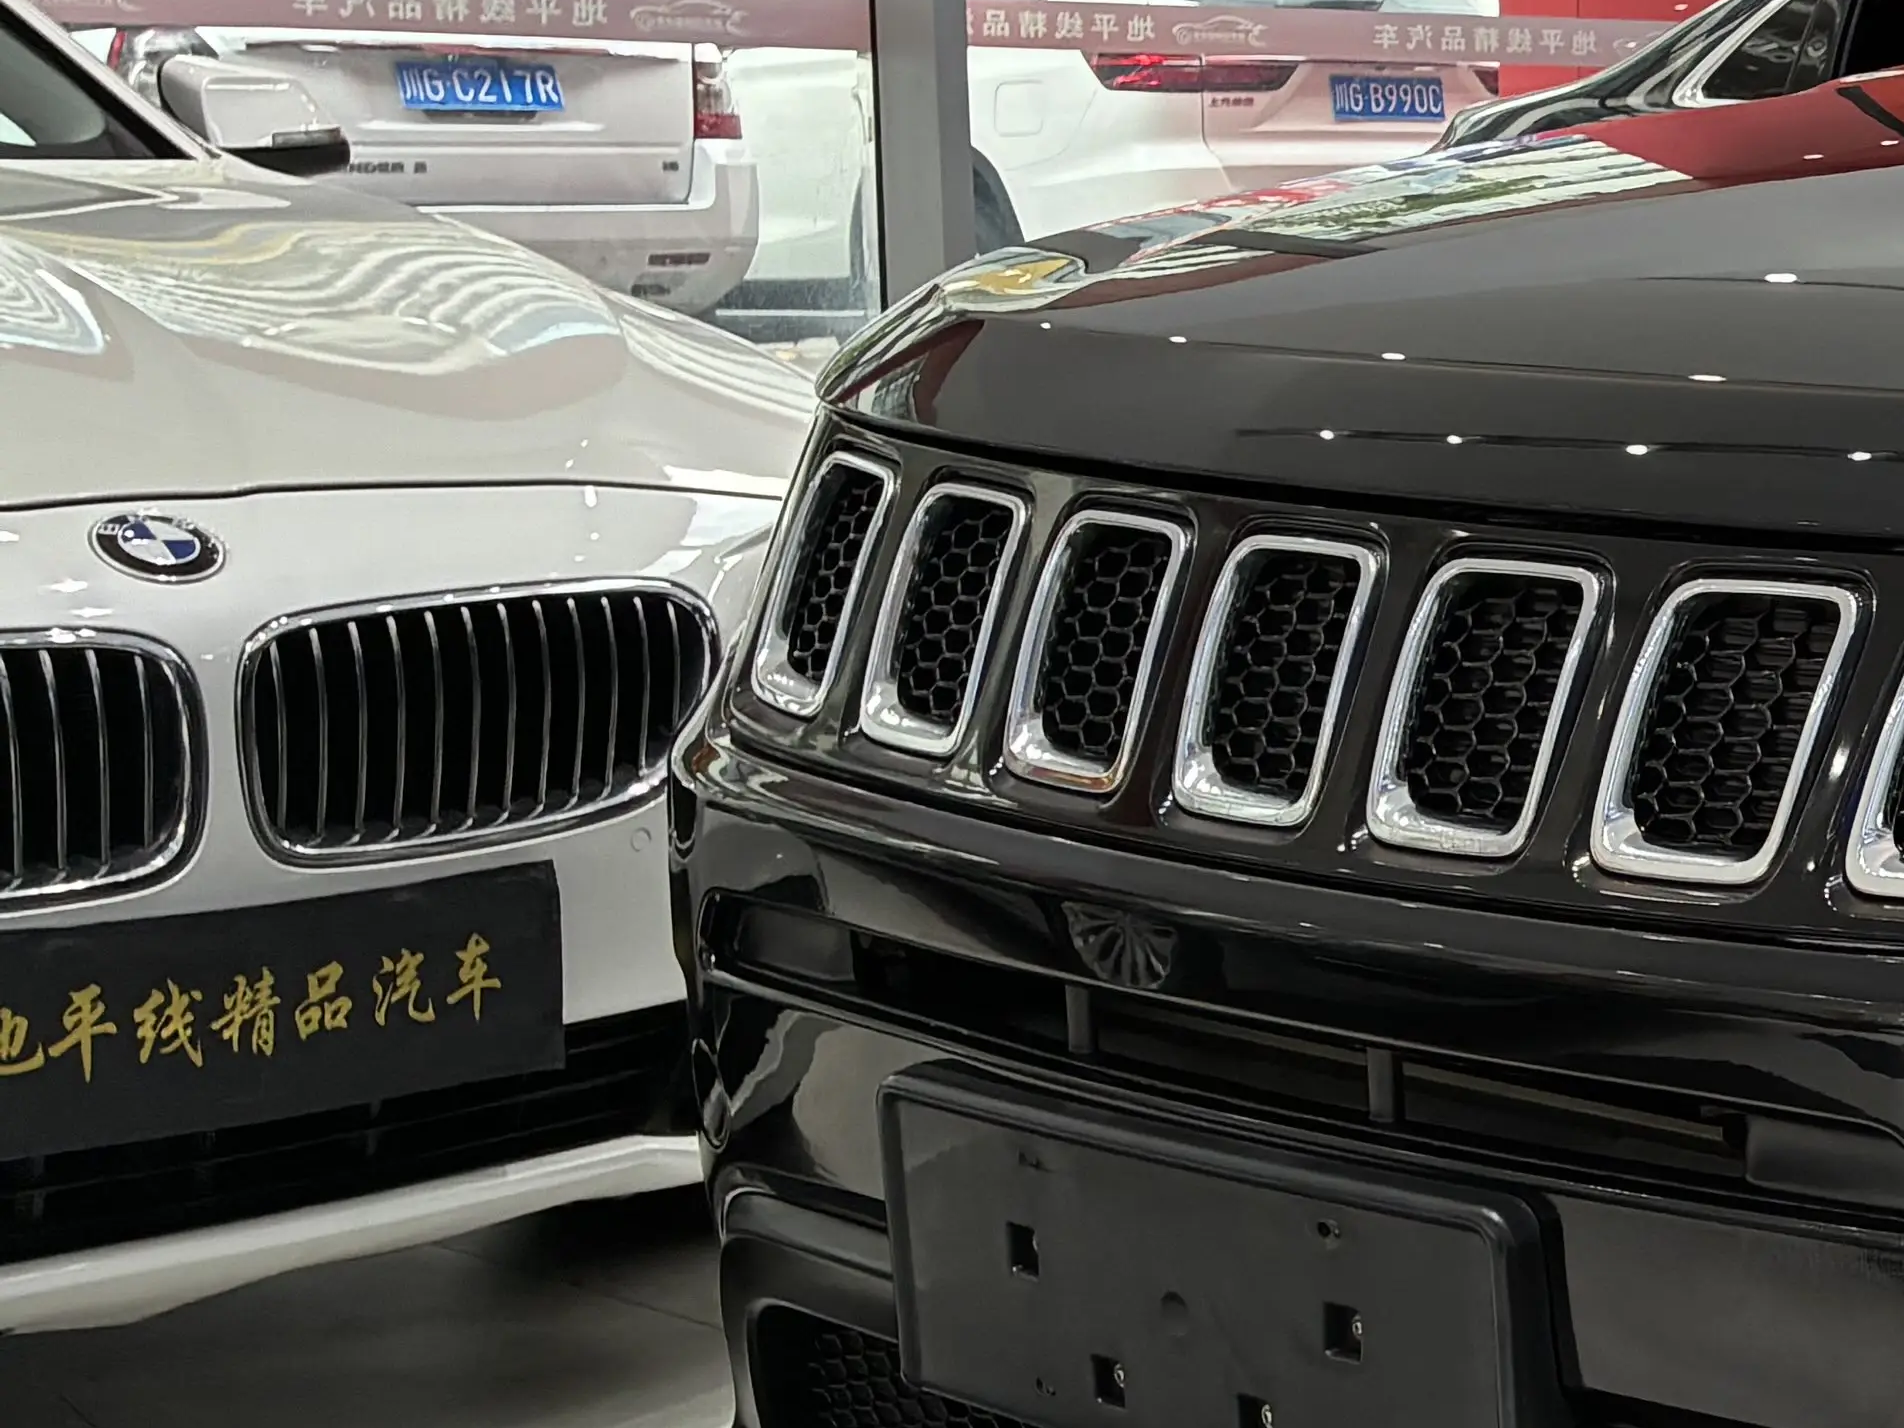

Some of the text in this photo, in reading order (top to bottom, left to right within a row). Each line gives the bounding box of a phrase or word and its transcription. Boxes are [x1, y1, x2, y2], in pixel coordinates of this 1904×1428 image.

[0, 933, 503, 1083] 地平线精品汽车
